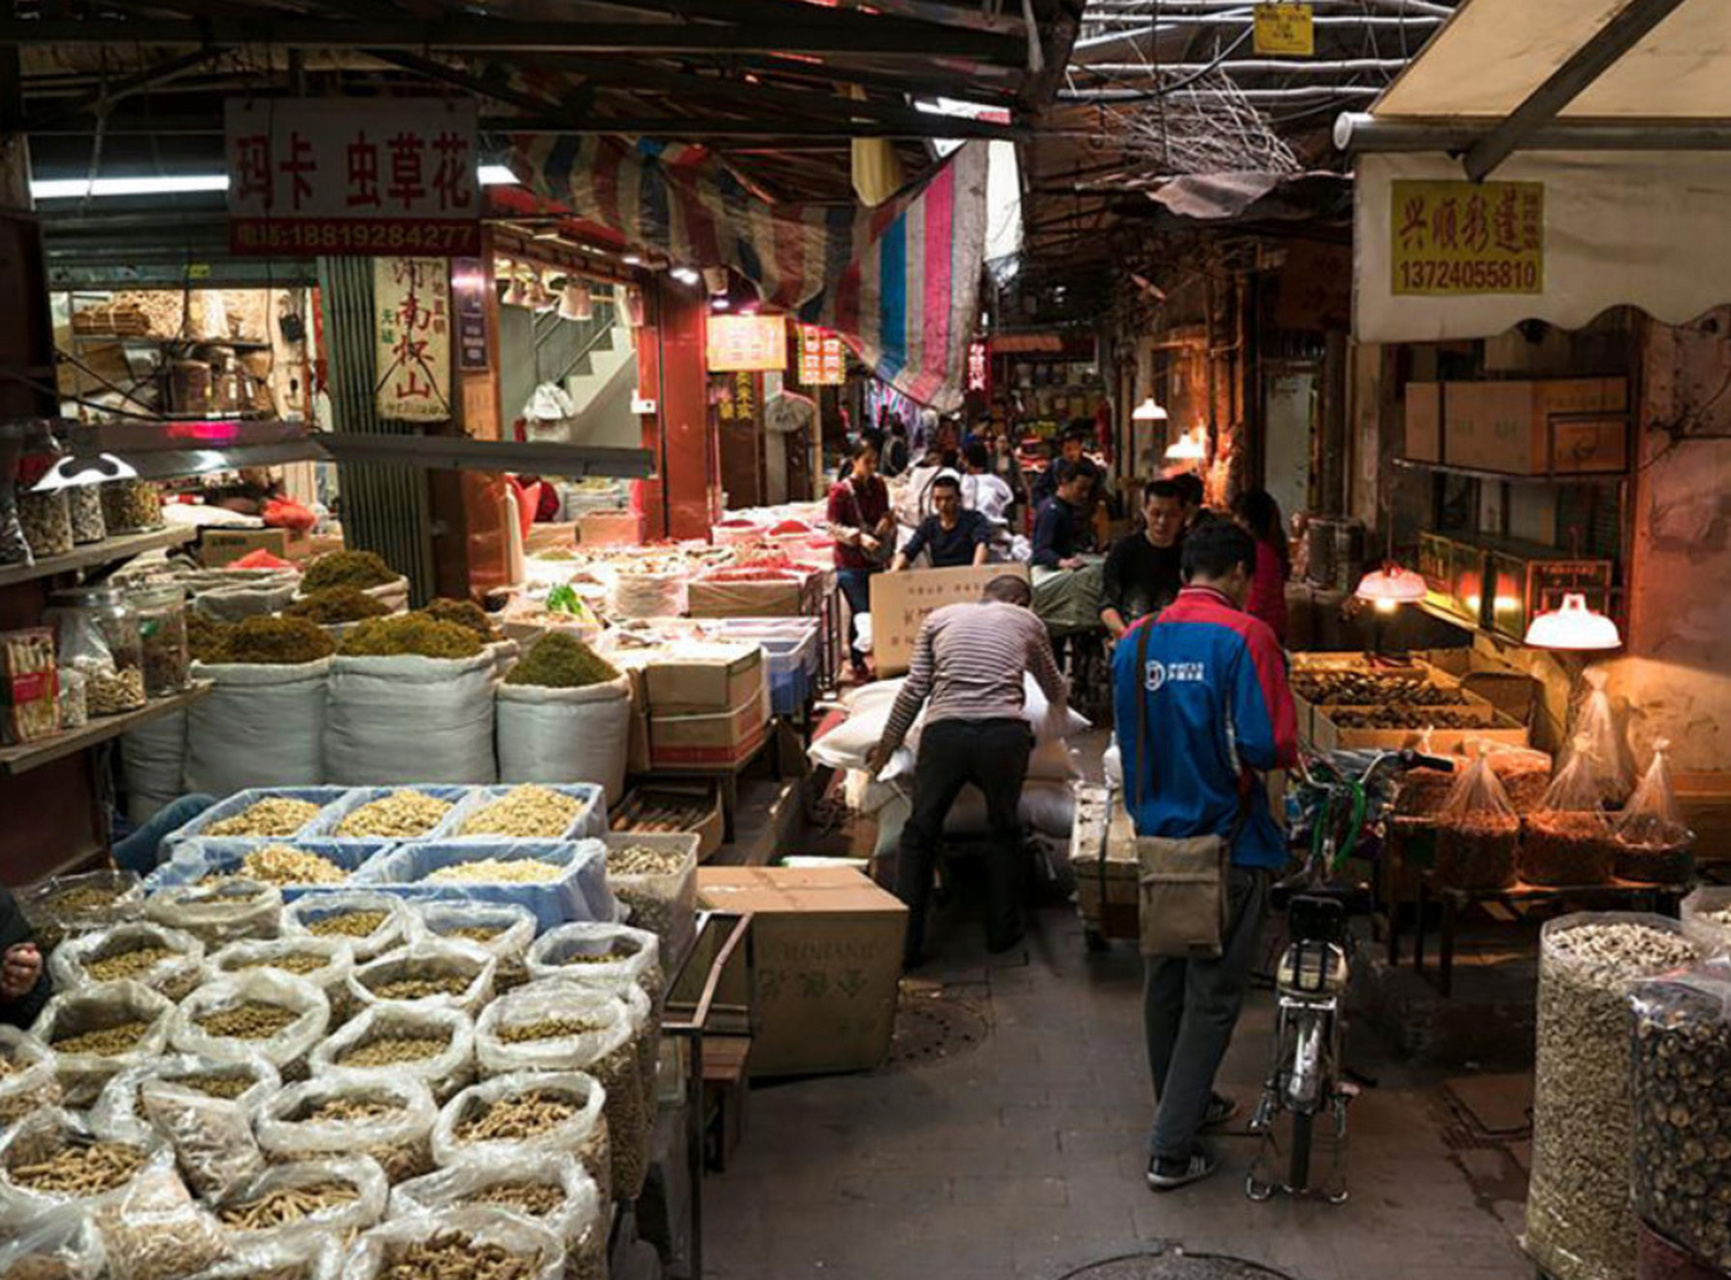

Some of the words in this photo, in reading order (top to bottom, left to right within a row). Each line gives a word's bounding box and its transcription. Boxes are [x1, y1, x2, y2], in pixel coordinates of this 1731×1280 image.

[236, 132, 316, 211] 玛卡
[345, 131, 471, 211] 虫草花
[1401, 260, 1536, 289] 13724055810
